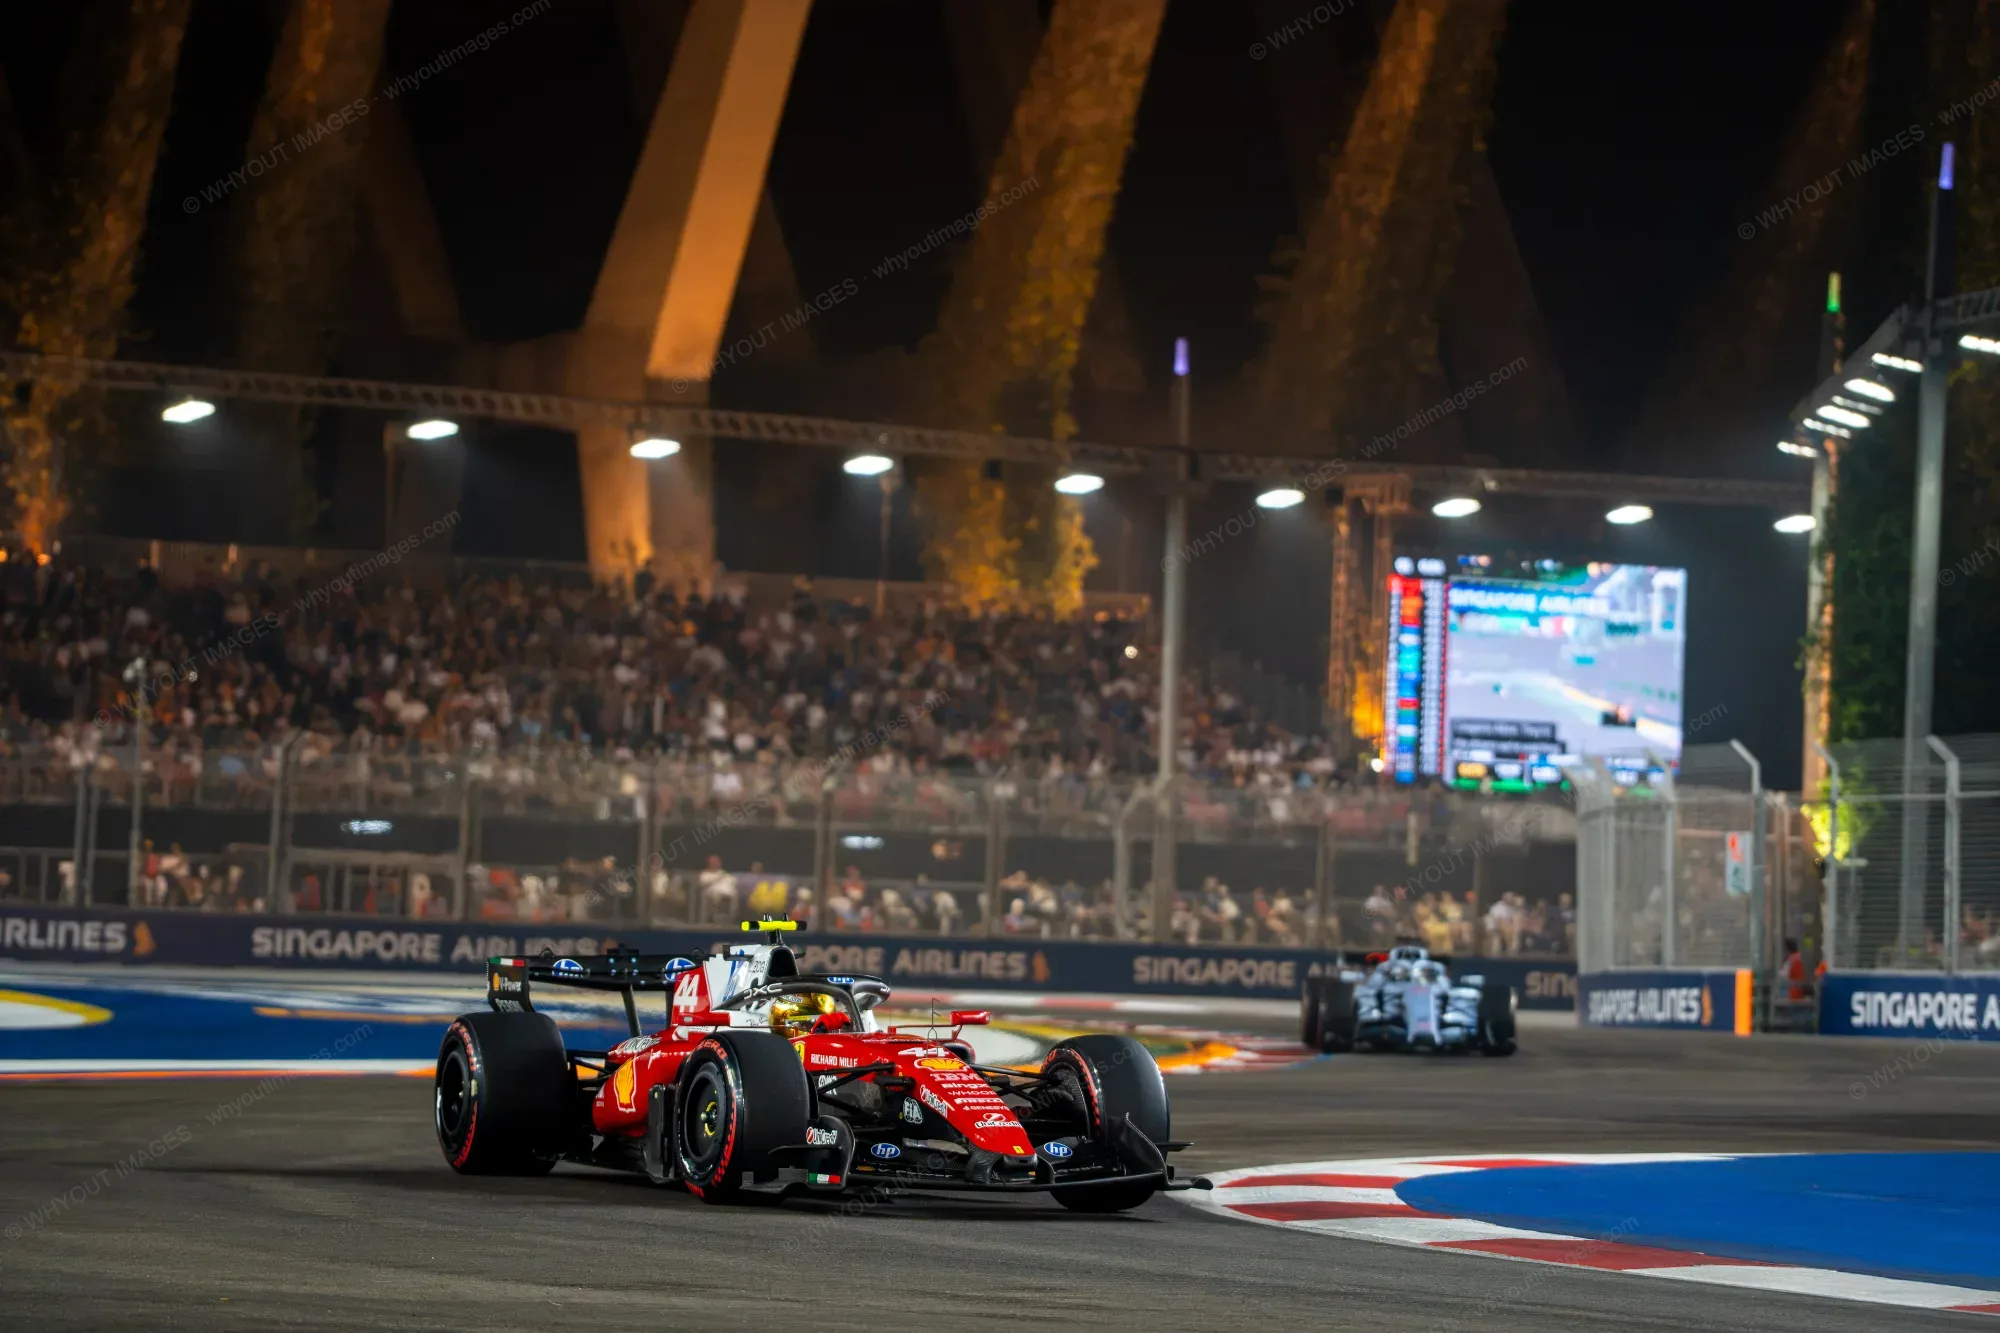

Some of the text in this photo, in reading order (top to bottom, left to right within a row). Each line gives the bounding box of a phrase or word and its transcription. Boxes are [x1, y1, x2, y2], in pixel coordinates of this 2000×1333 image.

[0, 917, 127, 953] RLINES
[252, 926, 442, 963] SINGAPORE
[892, 949, 1027, 980] AIRLINES
[1133, 956, 1296, 988] SINGAPORE
[673, 974, 700, 1013] 44
[1851, 991, 1978, 1029] SINGAPORE
[811, 1053, 838, 1066] RICHARD
[839, 1056, 859, 1068] MILLE
[898, 1047, 949, 1058] 44
[930, 1072, 984, 1082] IBM
[904, 1101, 919, 1117] FIA
[876, 1143, 896, 1158] hp
[1049, 1142, 1068, 1157] hp
